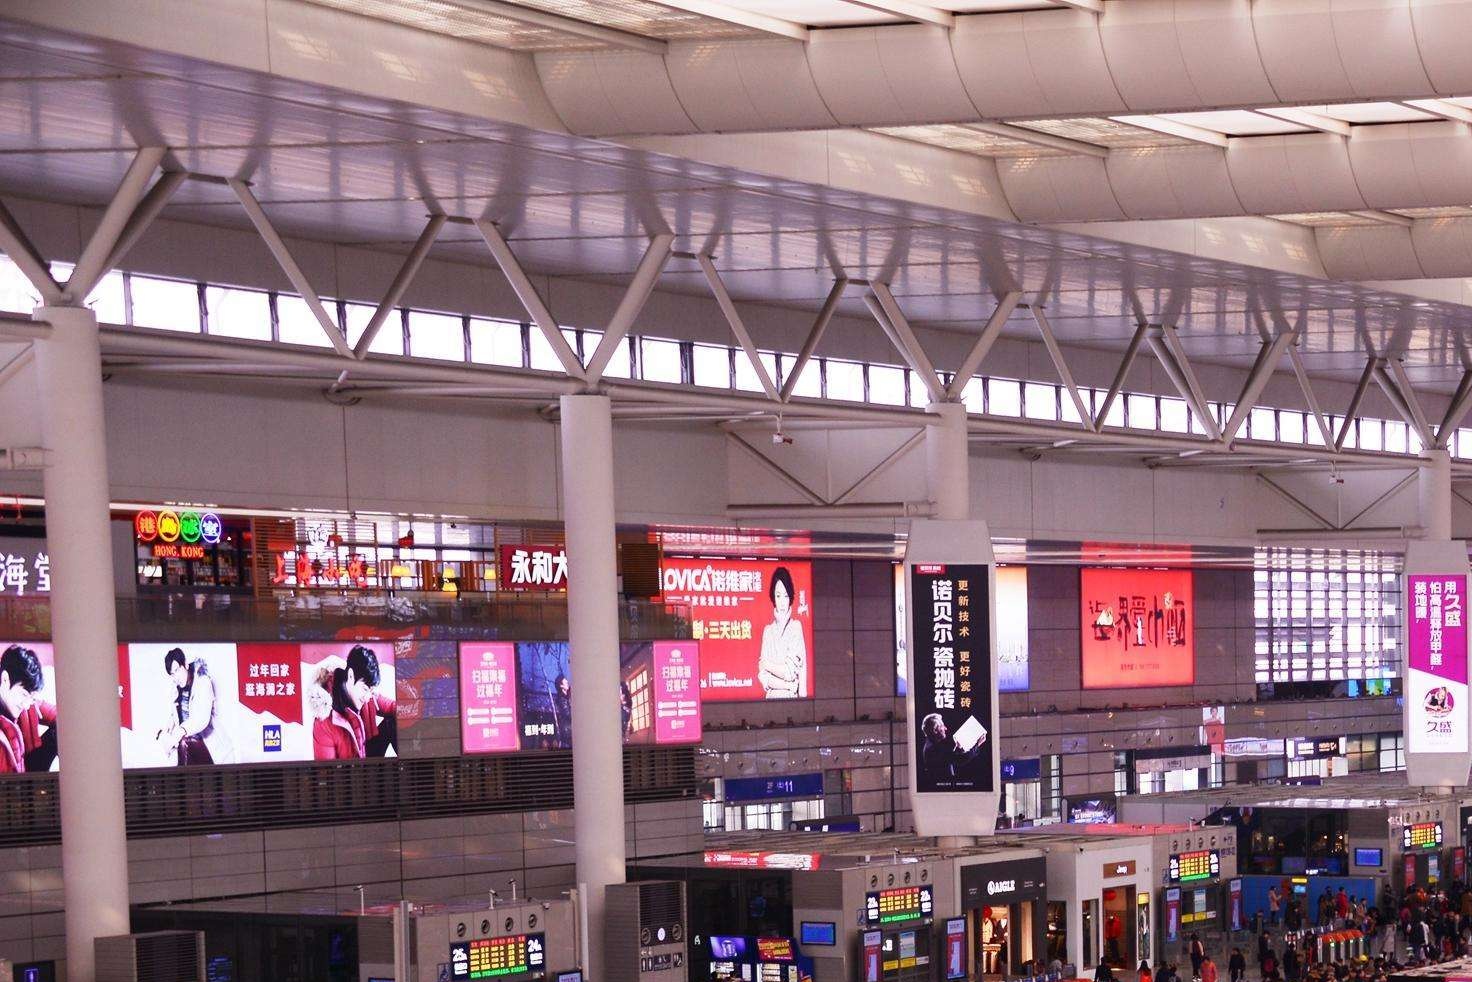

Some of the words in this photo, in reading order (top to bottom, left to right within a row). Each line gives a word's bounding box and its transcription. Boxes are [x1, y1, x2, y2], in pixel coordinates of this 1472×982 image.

[958, 580, 970, 638] 更新技术
[249, 663, 290, 678] 过年回家
[932, 579, 955, 709] 诺贝尔瓷抛砖
[245, 682, 296, 697] 逛海澜之家
[959, 651, 972, 708] 更好瓷砖
